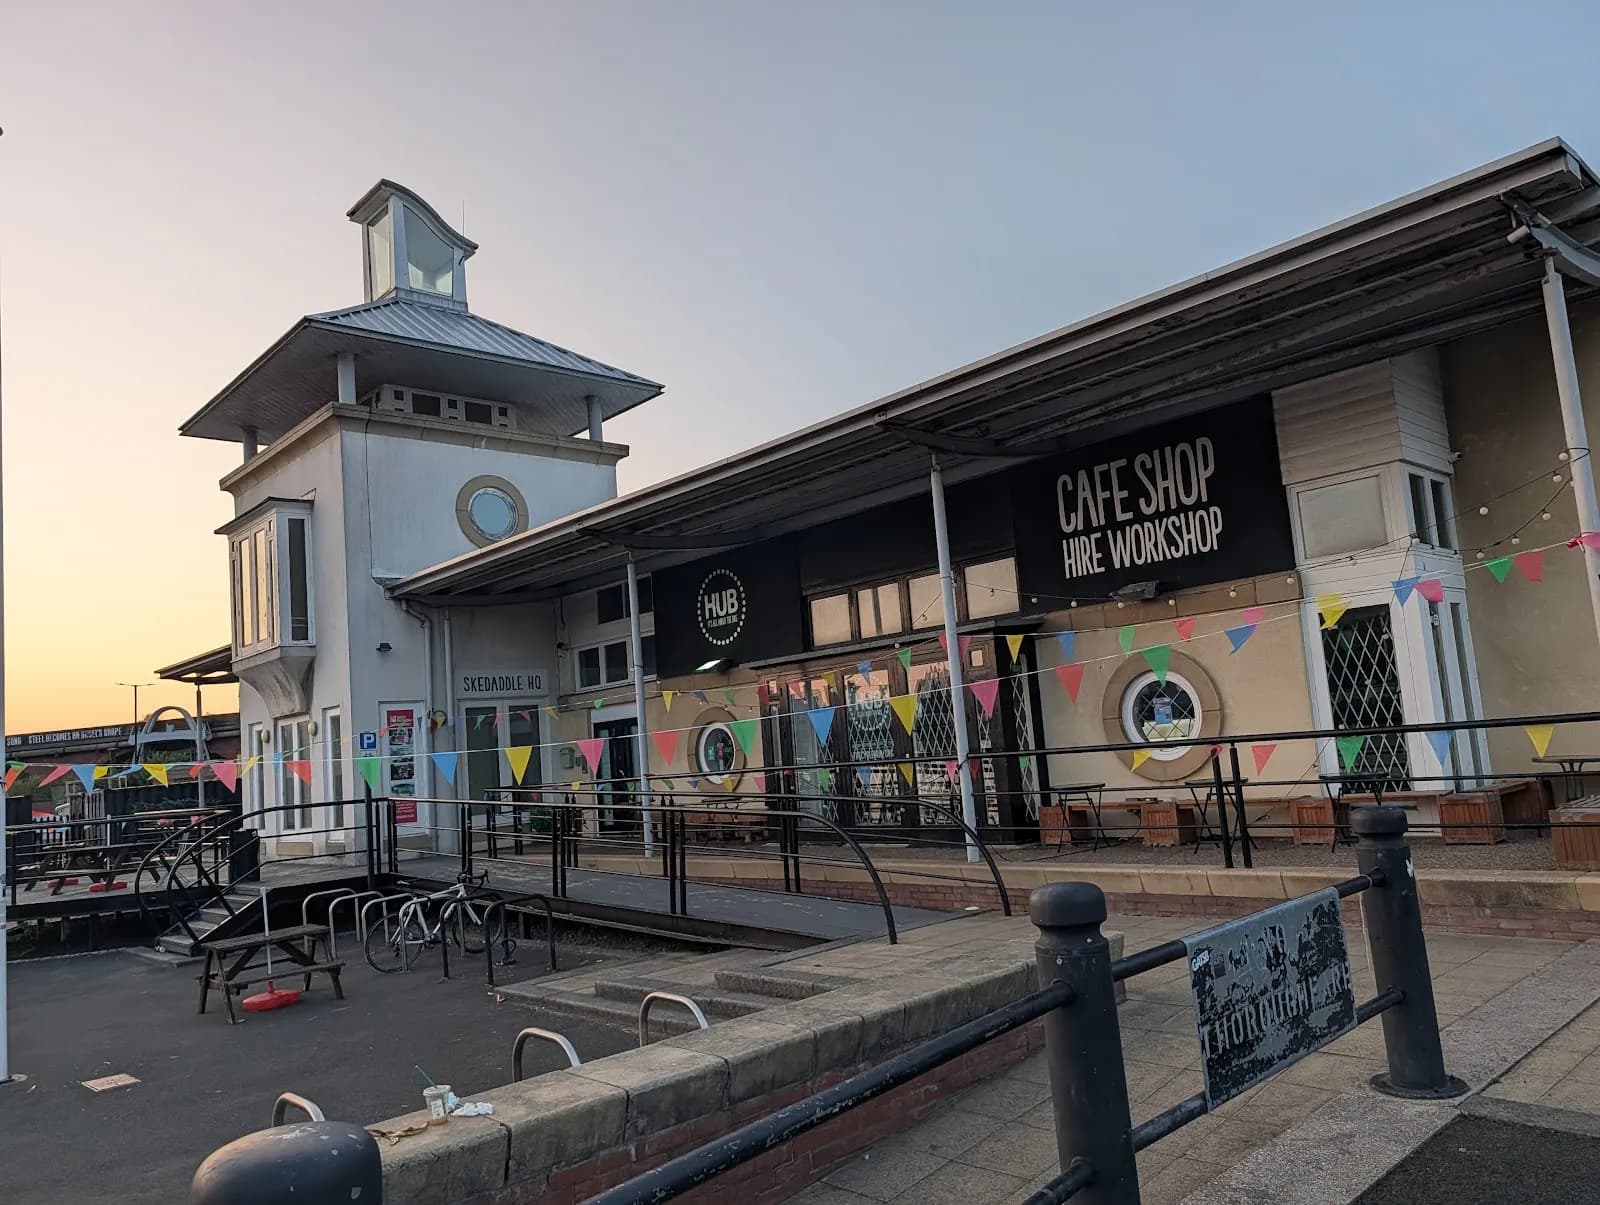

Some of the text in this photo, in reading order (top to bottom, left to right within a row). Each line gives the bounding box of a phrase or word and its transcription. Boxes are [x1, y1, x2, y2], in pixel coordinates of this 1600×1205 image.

[1056, 437, 1215, 533] CAFE SHOP
[1062, 506, 1223, 579] HIRE WORKSHOP
[704, 588, 739, 620] HUB
[463, 675, 542, 692] SKEDADDLE HQ
[363, 734, 375, 748] P
[1200, 962, 1352, 1060] THOROUGHFRE
